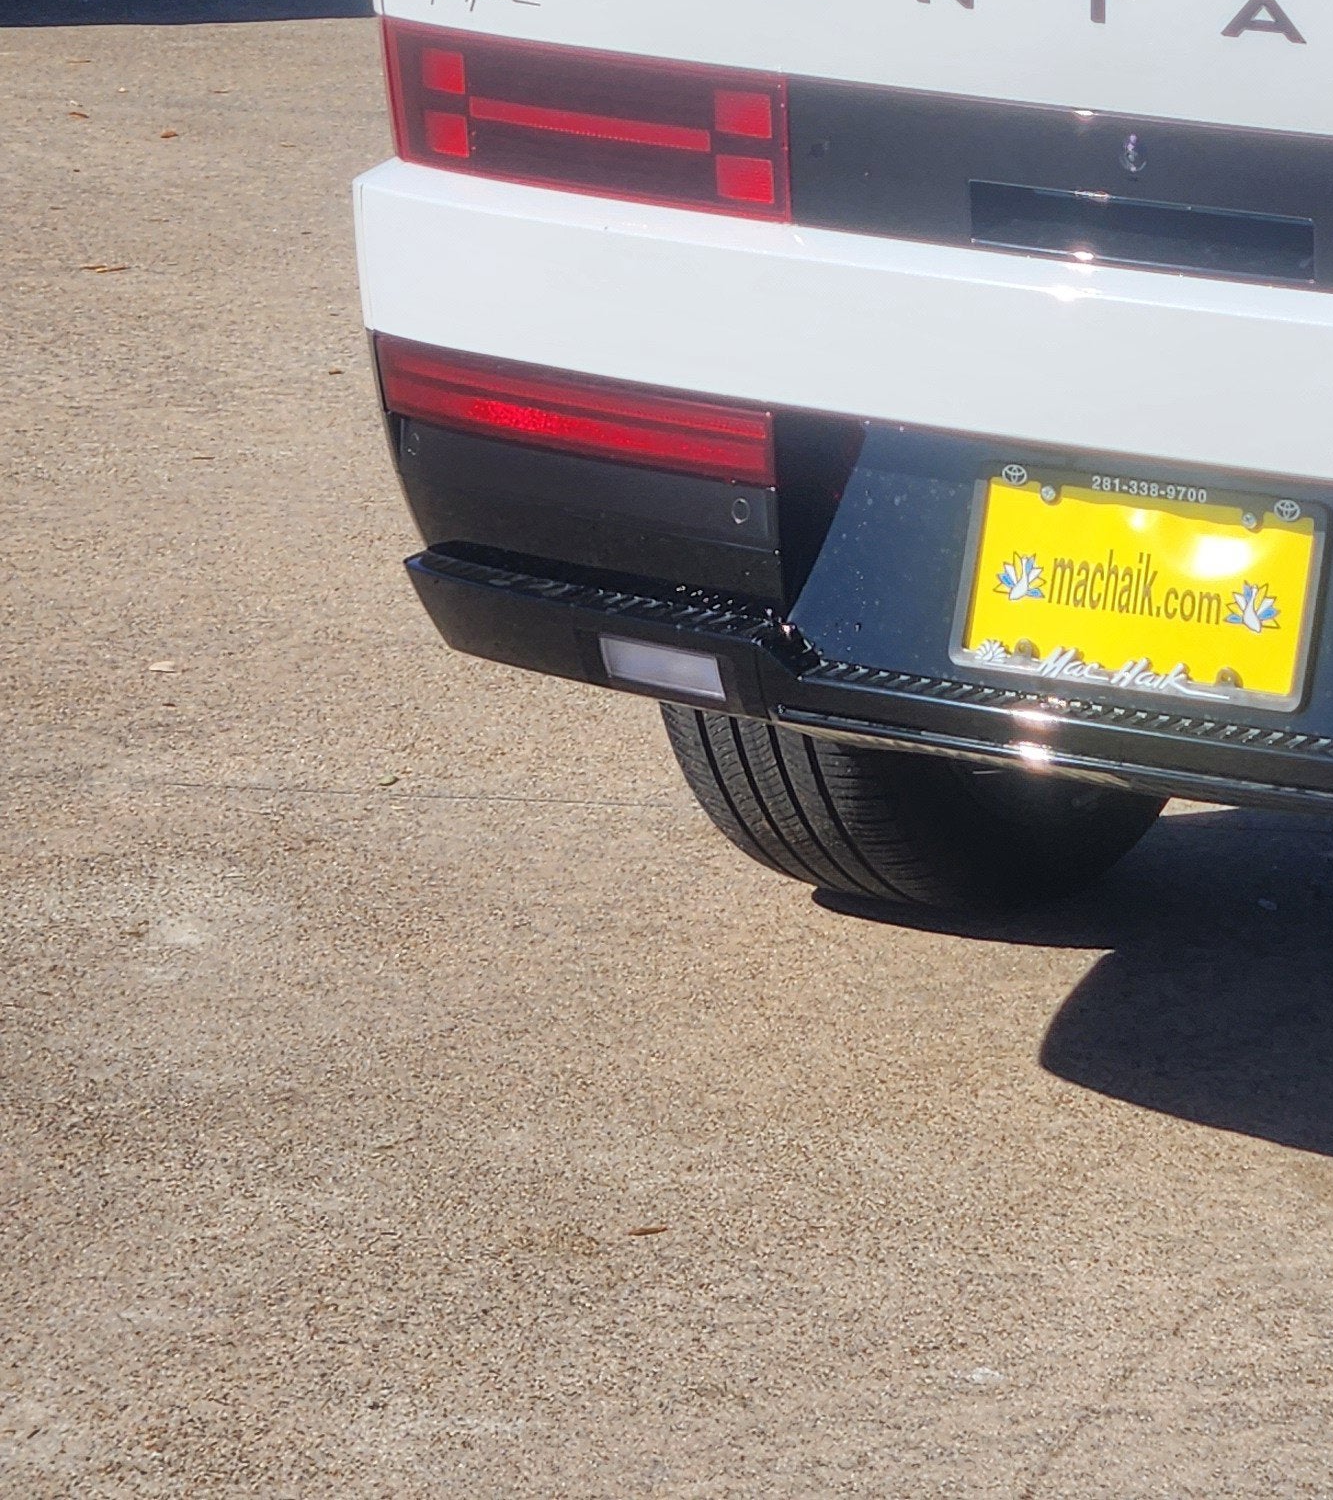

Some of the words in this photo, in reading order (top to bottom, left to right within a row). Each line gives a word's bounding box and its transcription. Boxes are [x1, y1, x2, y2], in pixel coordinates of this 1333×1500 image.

[1091, 475, 1208, 503] 281-338-9700
[1047, 549, 1222, 626] machaik.com
[1036, 646, 1108, 681] Mac
[1108, 656, 1230, 700] Haik
